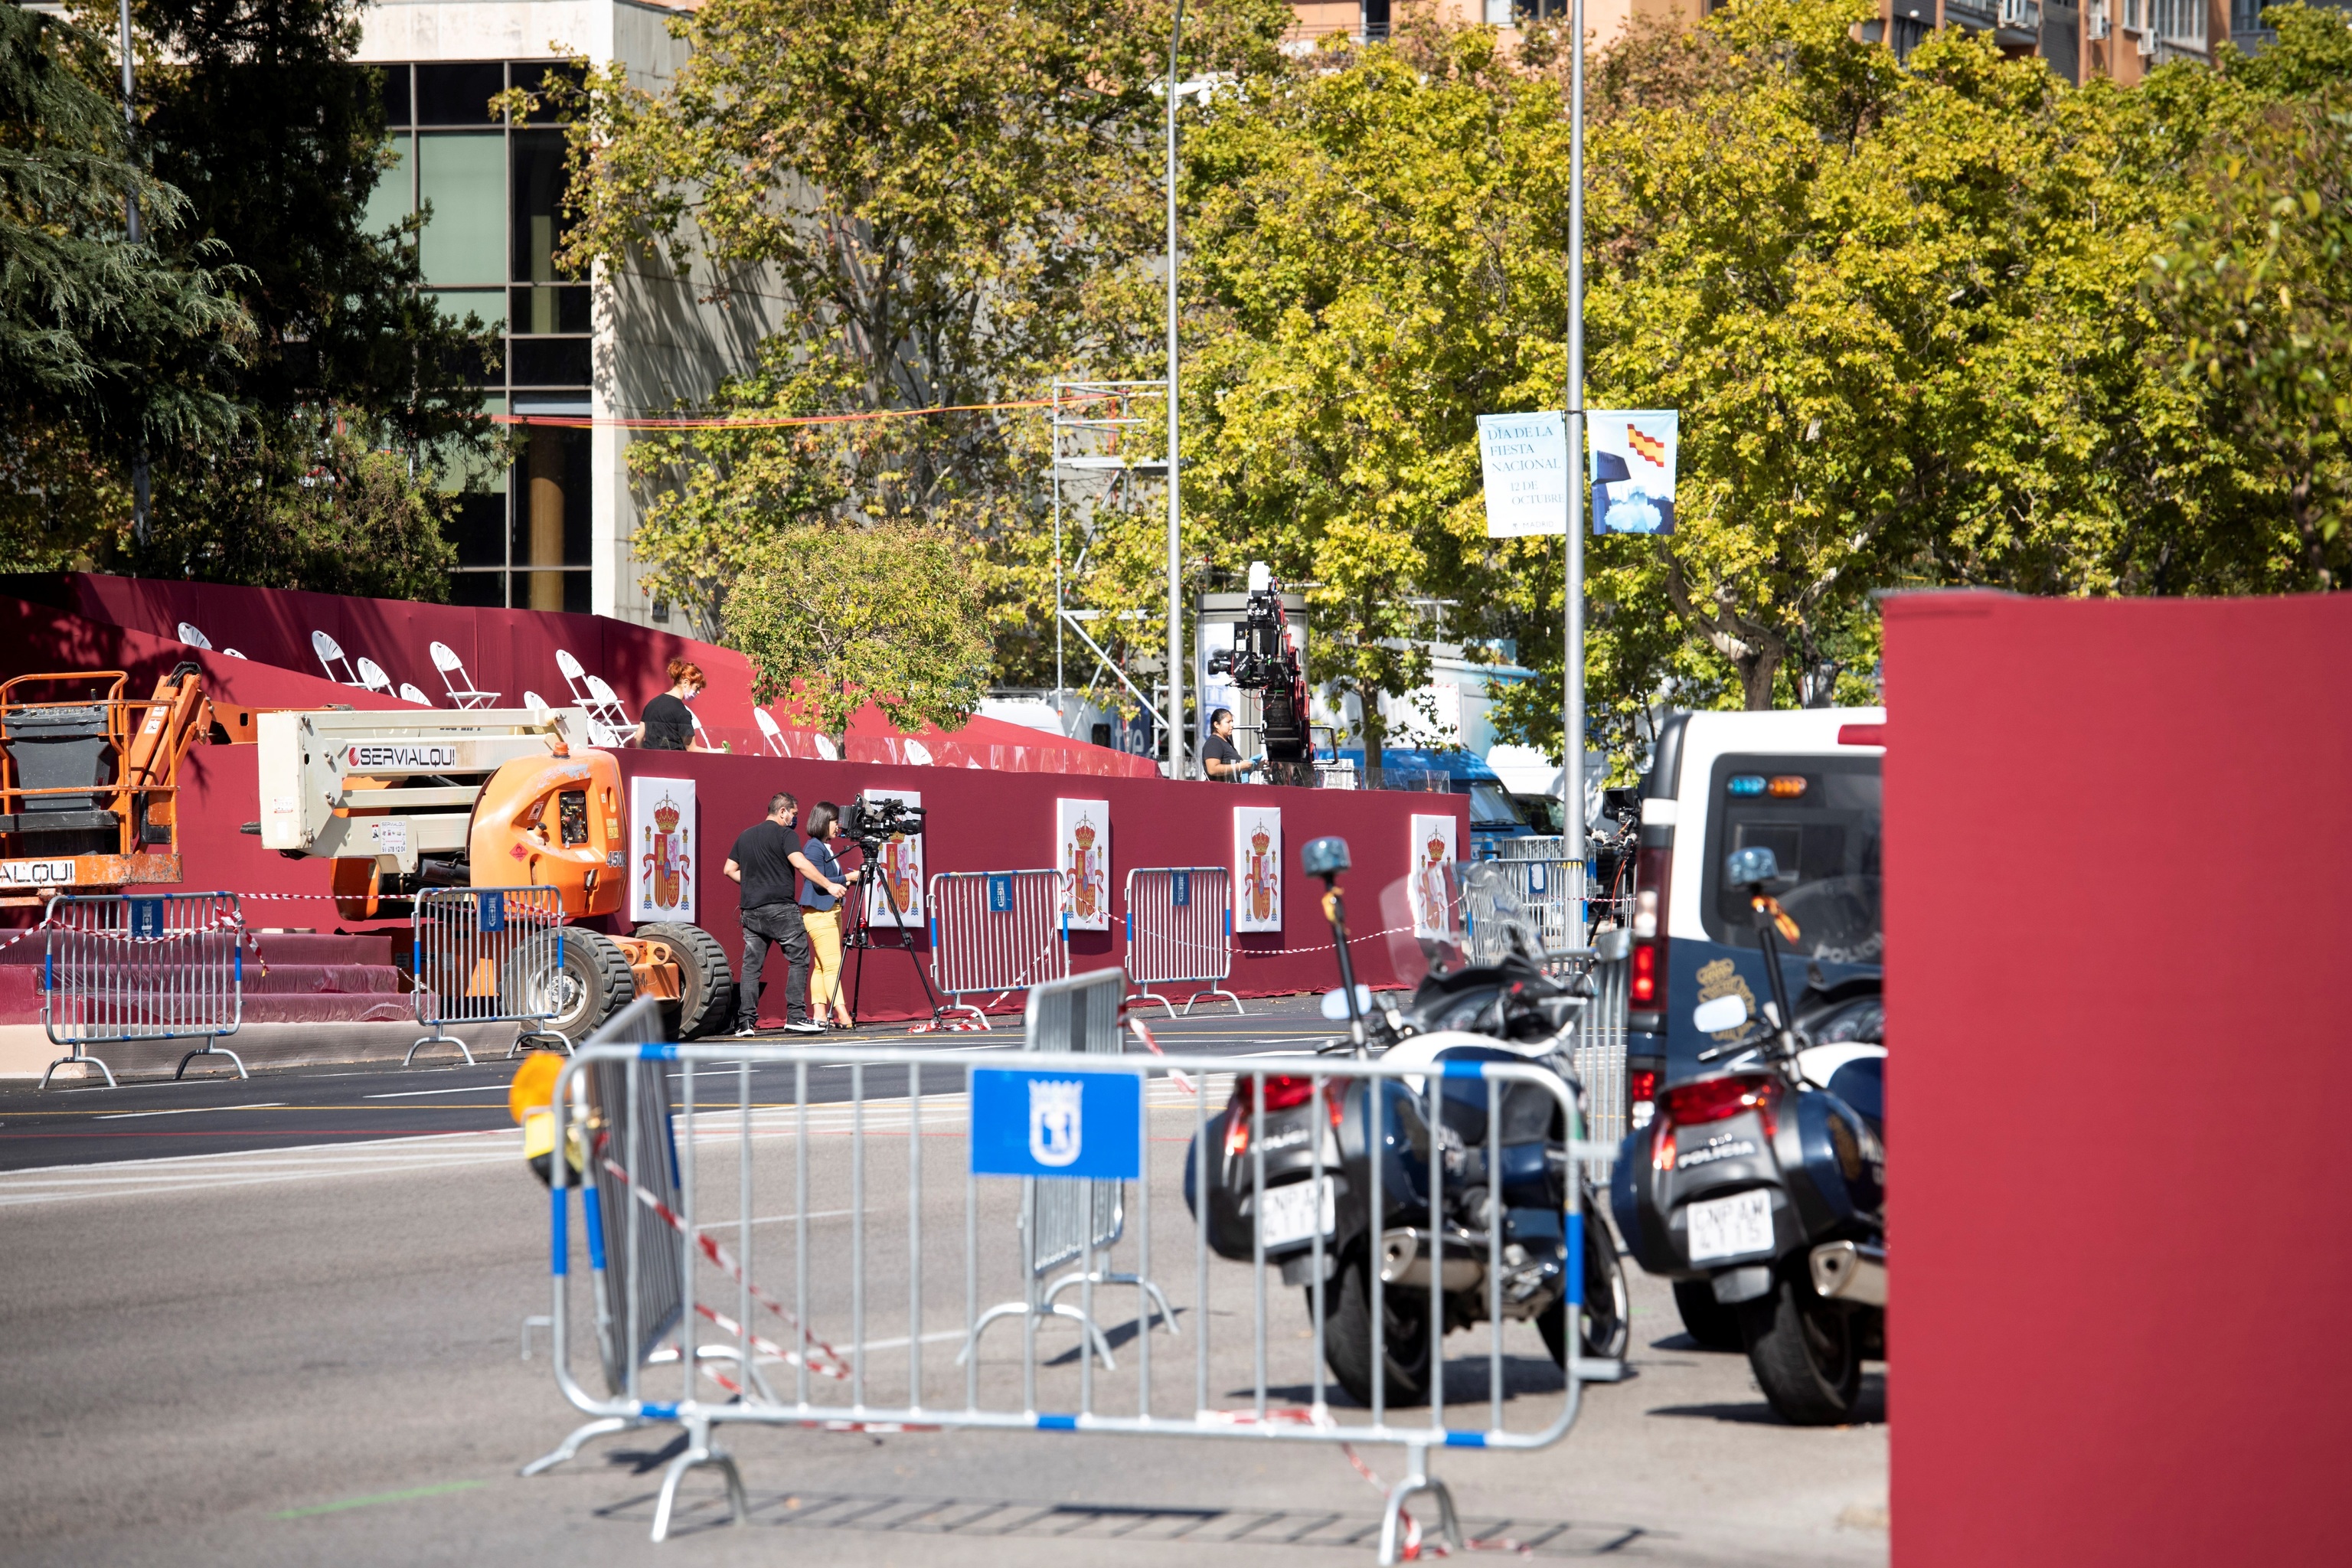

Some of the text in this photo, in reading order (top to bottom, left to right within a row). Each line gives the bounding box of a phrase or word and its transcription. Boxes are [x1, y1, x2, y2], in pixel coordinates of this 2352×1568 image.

[1488, 426, 1553, 440] DÍA DE LA
[1489, 443, 1534, 456] FIESTA
[1491, 458, 1561, 473] NACIONAL
[1510, 480, 1538, 492] 12 DE
[1511, 493, 1565, 505] OCTUBRE
[1523, 521, 1554, 529] MADRID
[360, 748, 455, 767] SERVIALQUI
[1677, 1141, 1755, 1168] POLICIA
